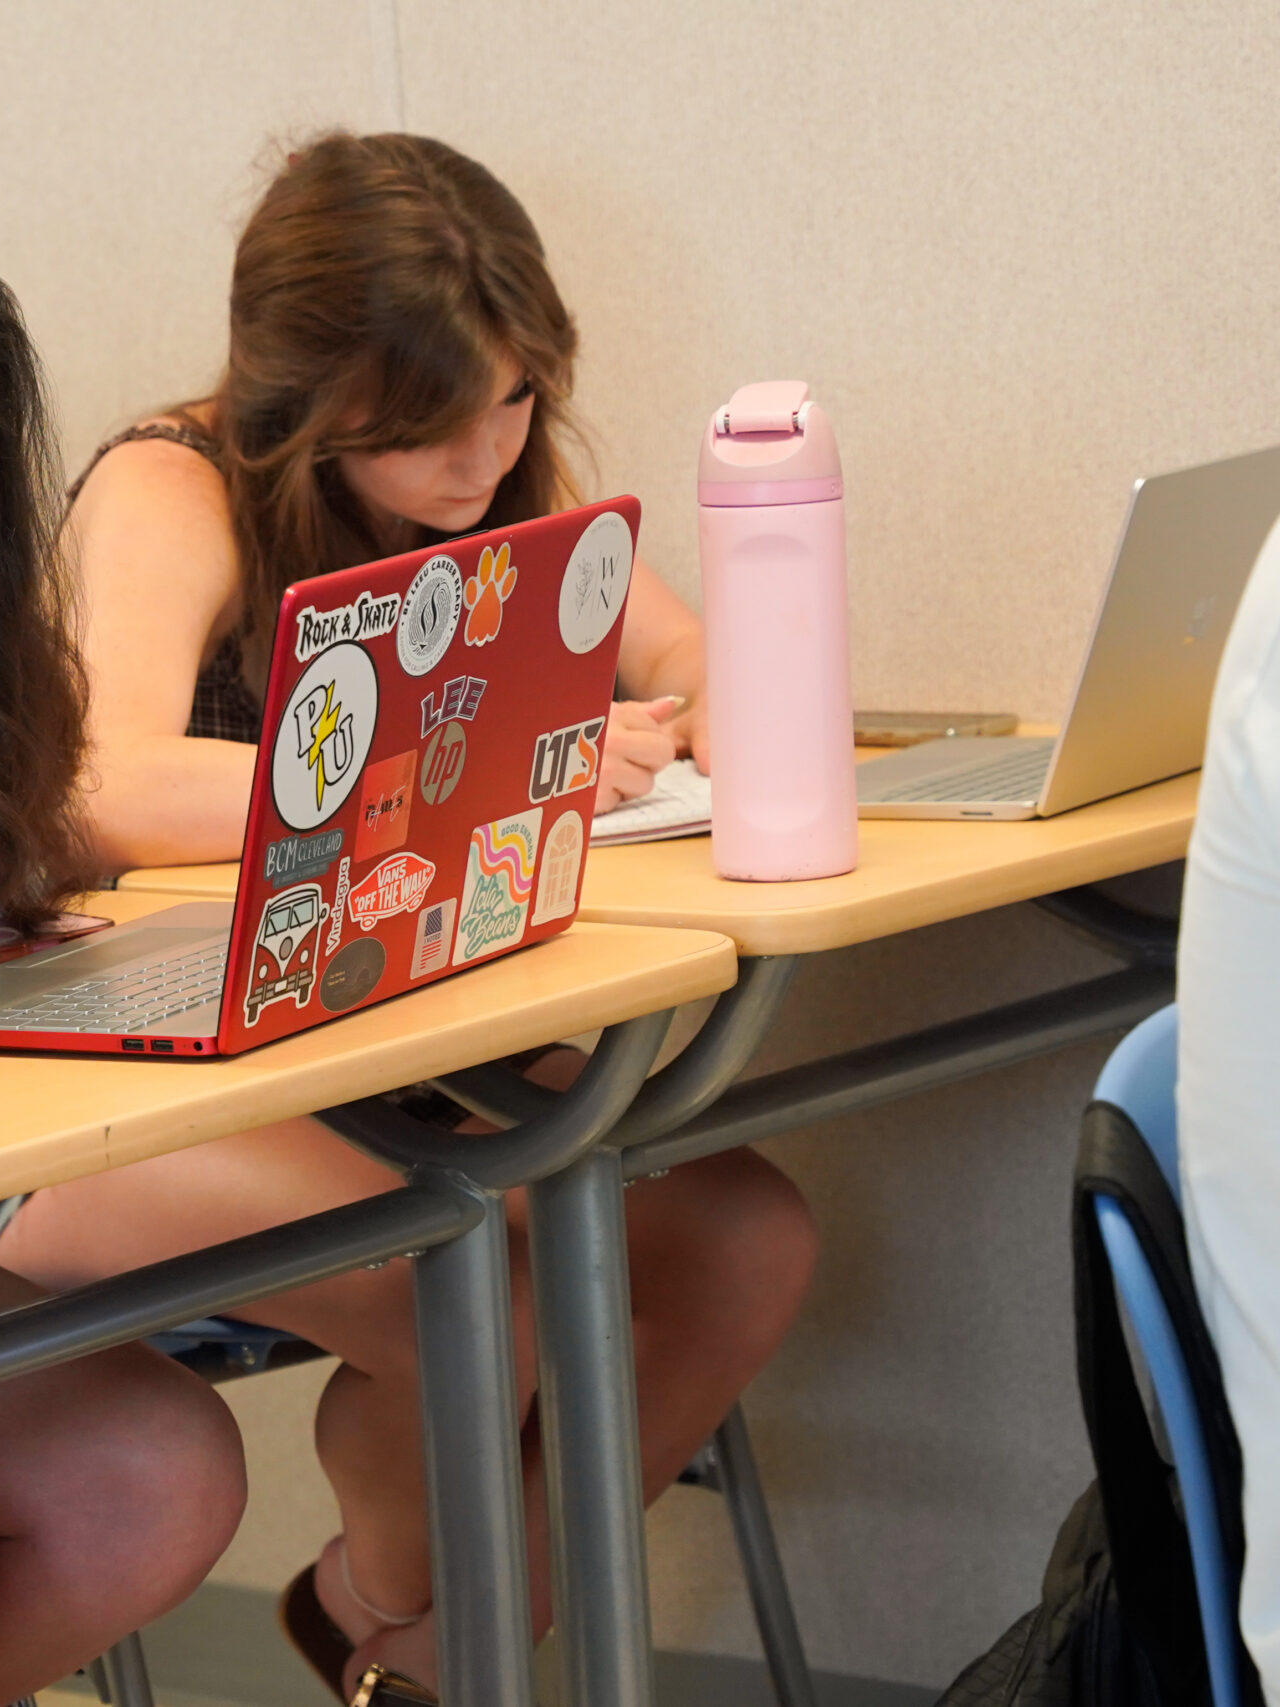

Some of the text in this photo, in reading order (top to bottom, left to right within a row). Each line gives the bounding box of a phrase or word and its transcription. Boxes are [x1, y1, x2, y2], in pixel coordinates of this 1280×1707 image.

[431, 559, 457, 577] CAREER
[453, 578, 461, 621] READY
[341, 612, 351, 638] &
[420, 675, 488, 739] LEE
[423, 722, 464, 806] hp
[531, 721, 604, 800] UTS
[266, 838, 298, 877] BCM
[298, 832, 342, 862] CLEVELAND
[501, 823, 519, 837] GOOD
[377, 858, 408, 888] VANS
[379, 880, 401, 909] THE
[465, 905, 521, 959] Beans
